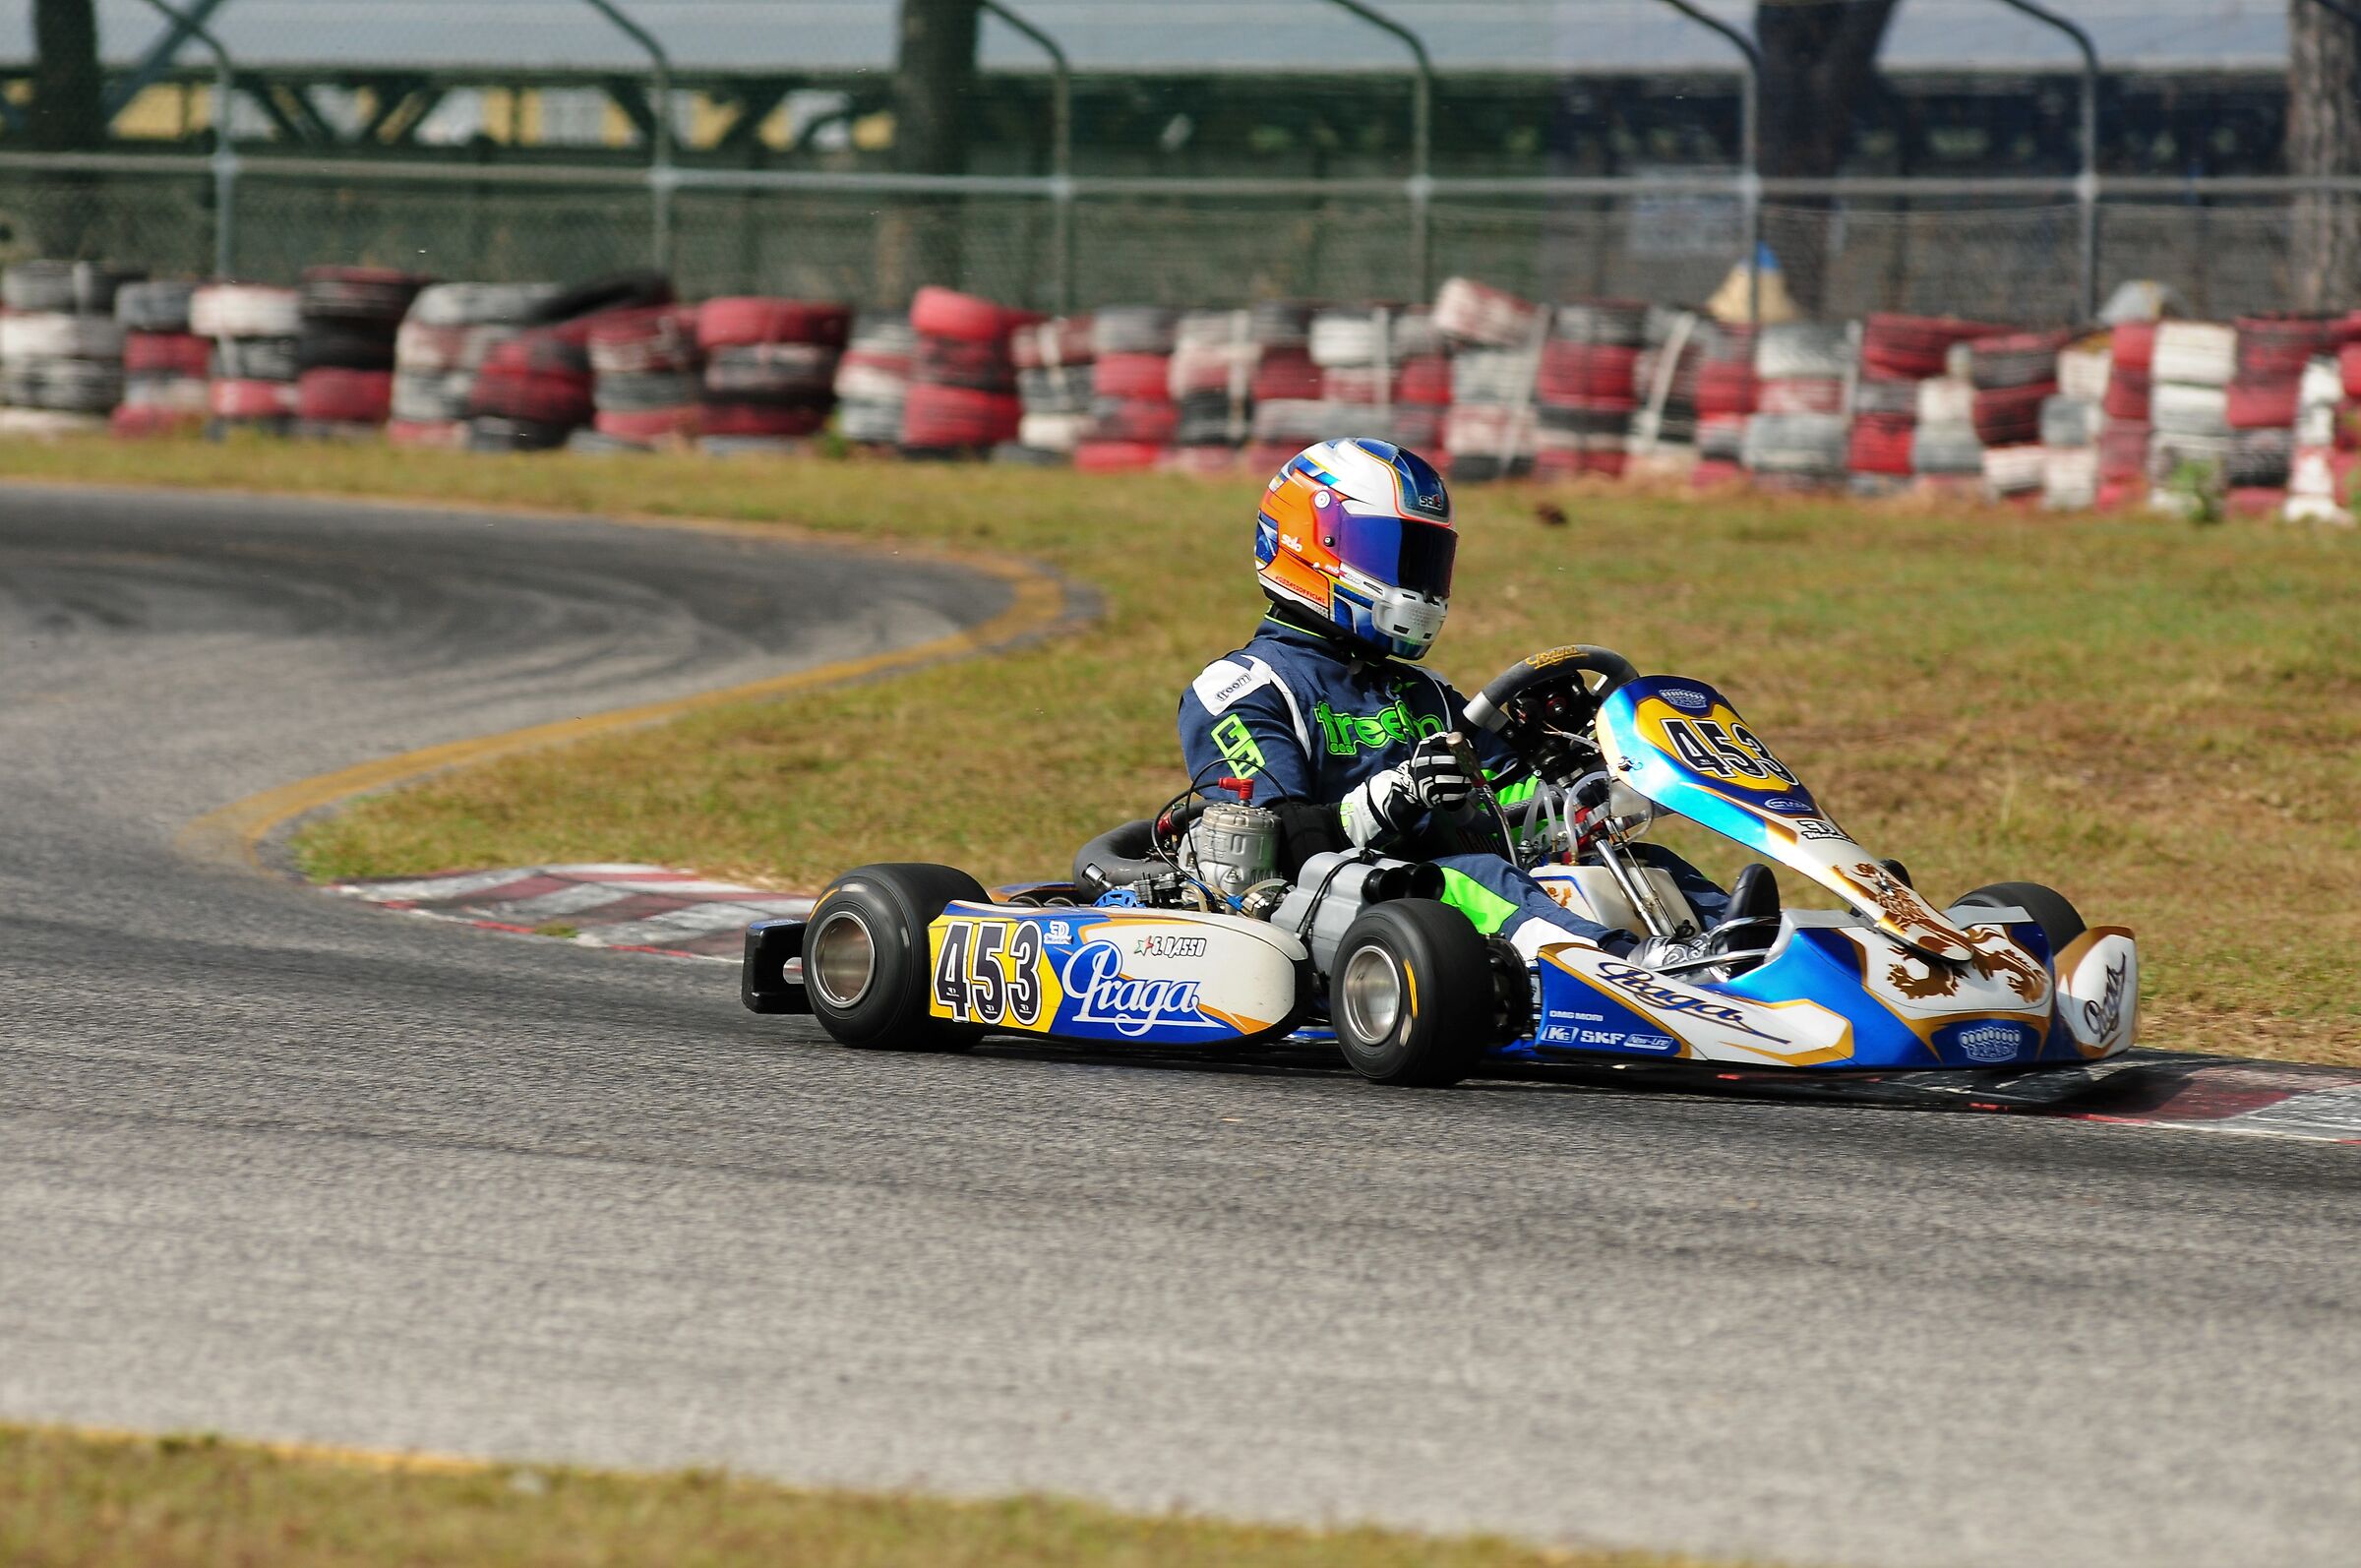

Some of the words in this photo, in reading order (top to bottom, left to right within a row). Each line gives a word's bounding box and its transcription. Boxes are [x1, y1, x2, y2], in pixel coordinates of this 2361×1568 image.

[1661, 719, 1799, 785] 453
[934, 921, 1042, 1025] 453
[1062, 939, 1227, 1037] Praga
[1596, 962, 1777, 1037] Praga
[1580, 1030, 1626, 1045] SKF
